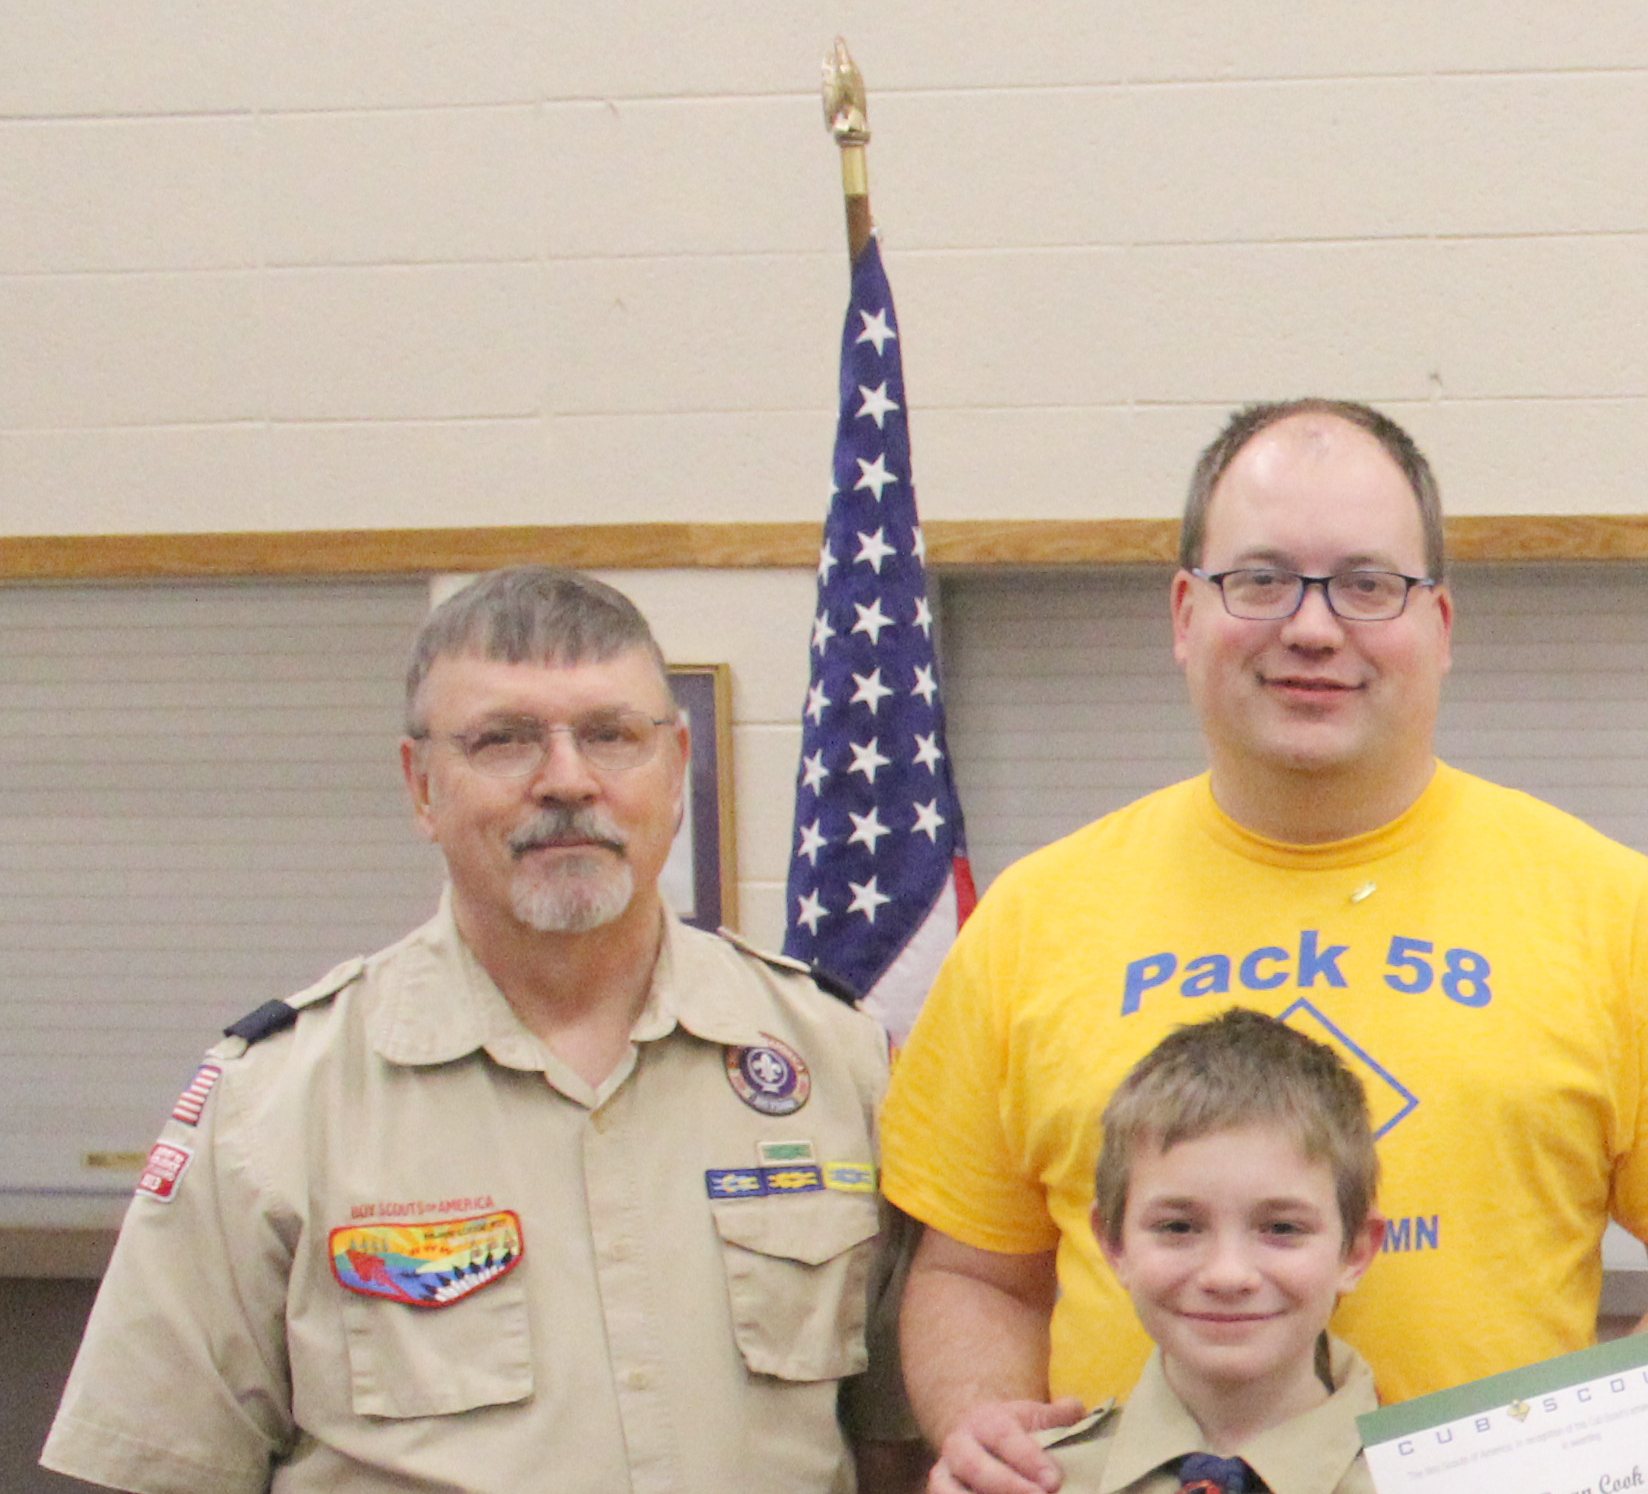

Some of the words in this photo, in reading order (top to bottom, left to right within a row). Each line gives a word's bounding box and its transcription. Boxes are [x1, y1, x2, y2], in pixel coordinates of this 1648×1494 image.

[1120, 930, 1349, 1017] Pack
[1383, 935, 1492, 1008] 58
[1382, 1215, 1439, 1253] MN
[1397, 1418, 1491, 1456] CUB
